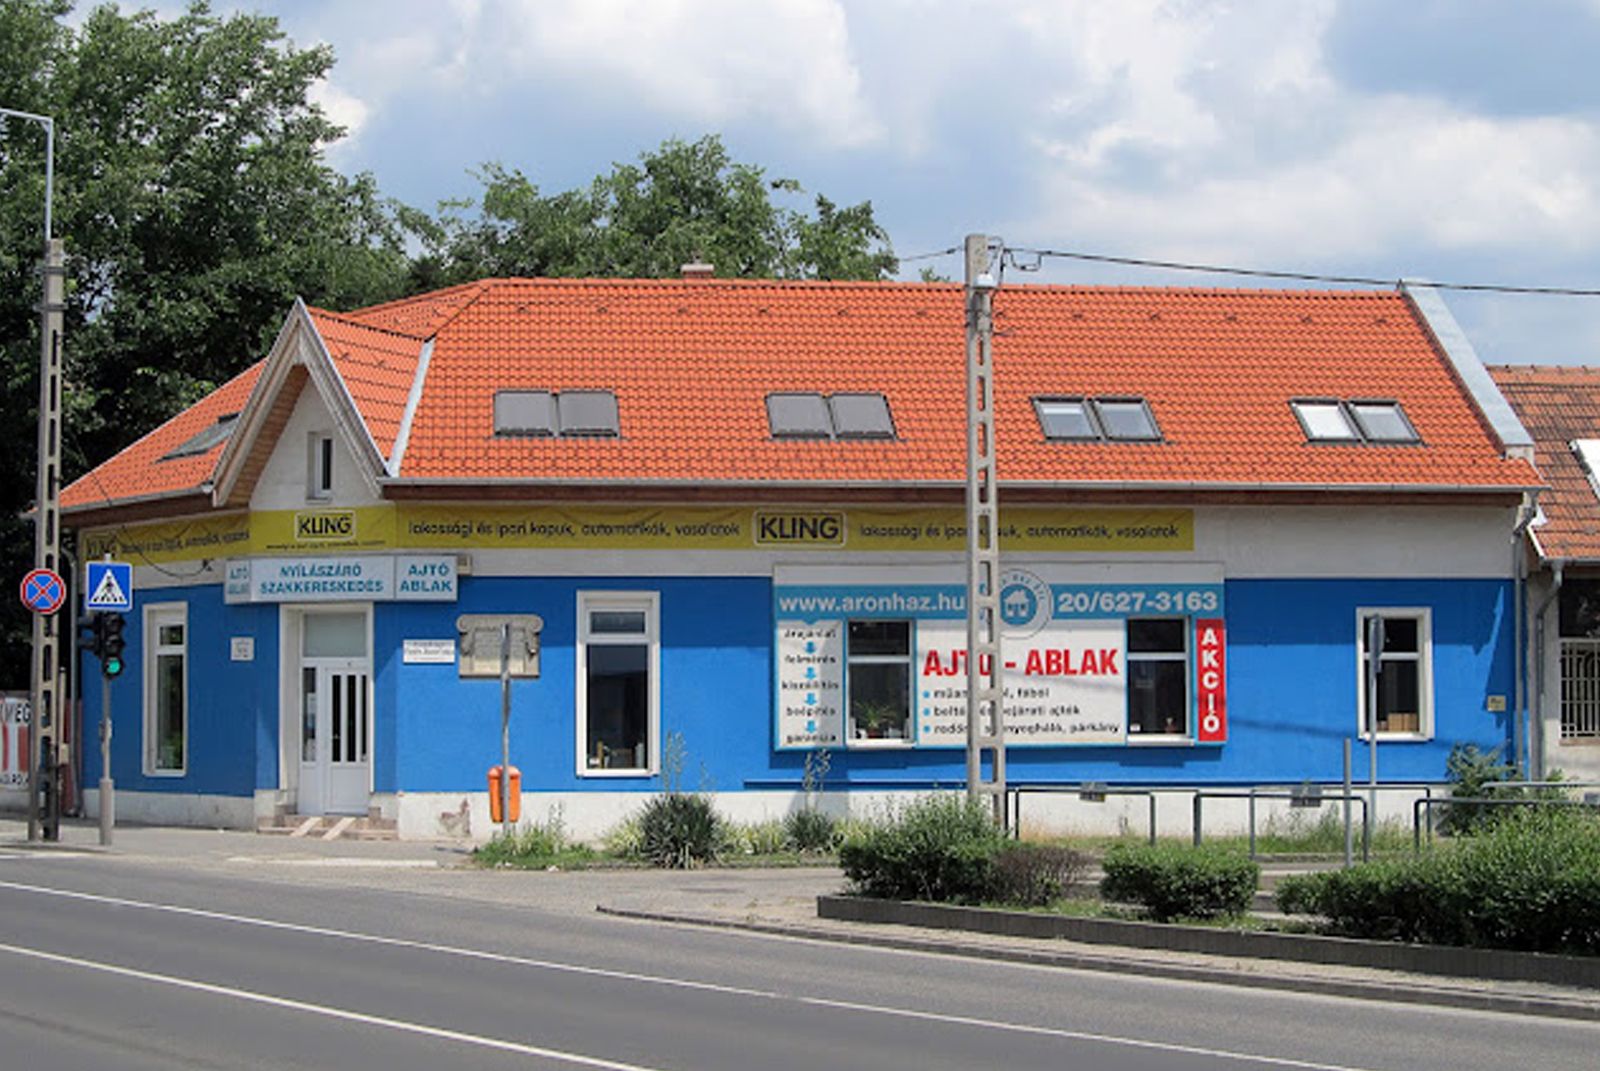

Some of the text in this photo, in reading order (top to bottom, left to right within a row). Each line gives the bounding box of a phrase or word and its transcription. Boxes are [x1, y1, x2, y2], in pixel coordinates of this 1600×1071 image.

[299, 517, 351, 535] KLING
[477, 521, 493, 536] és
[530, 520, 576, 540] kapuk,
[760, 517, 839, 539] KLING
[926, 525, 940, 538] és
[280, 562, 363, 577] NYÍLÁSZÁRÓ
[408, 562, 450, 576] AJTÓ
[260, 580, 384, 594] SZAKKERESKEDÉS
[399, 580, 453, 592] ABLAK
[778, 593, 966, 611] www.aronhaz.hu
[1058, 592, 1217, 612] 20/627-3163
[1024, 648, 1119, 676] ABLAK
[1201, 628, 1220, 732] AKCIÓ
